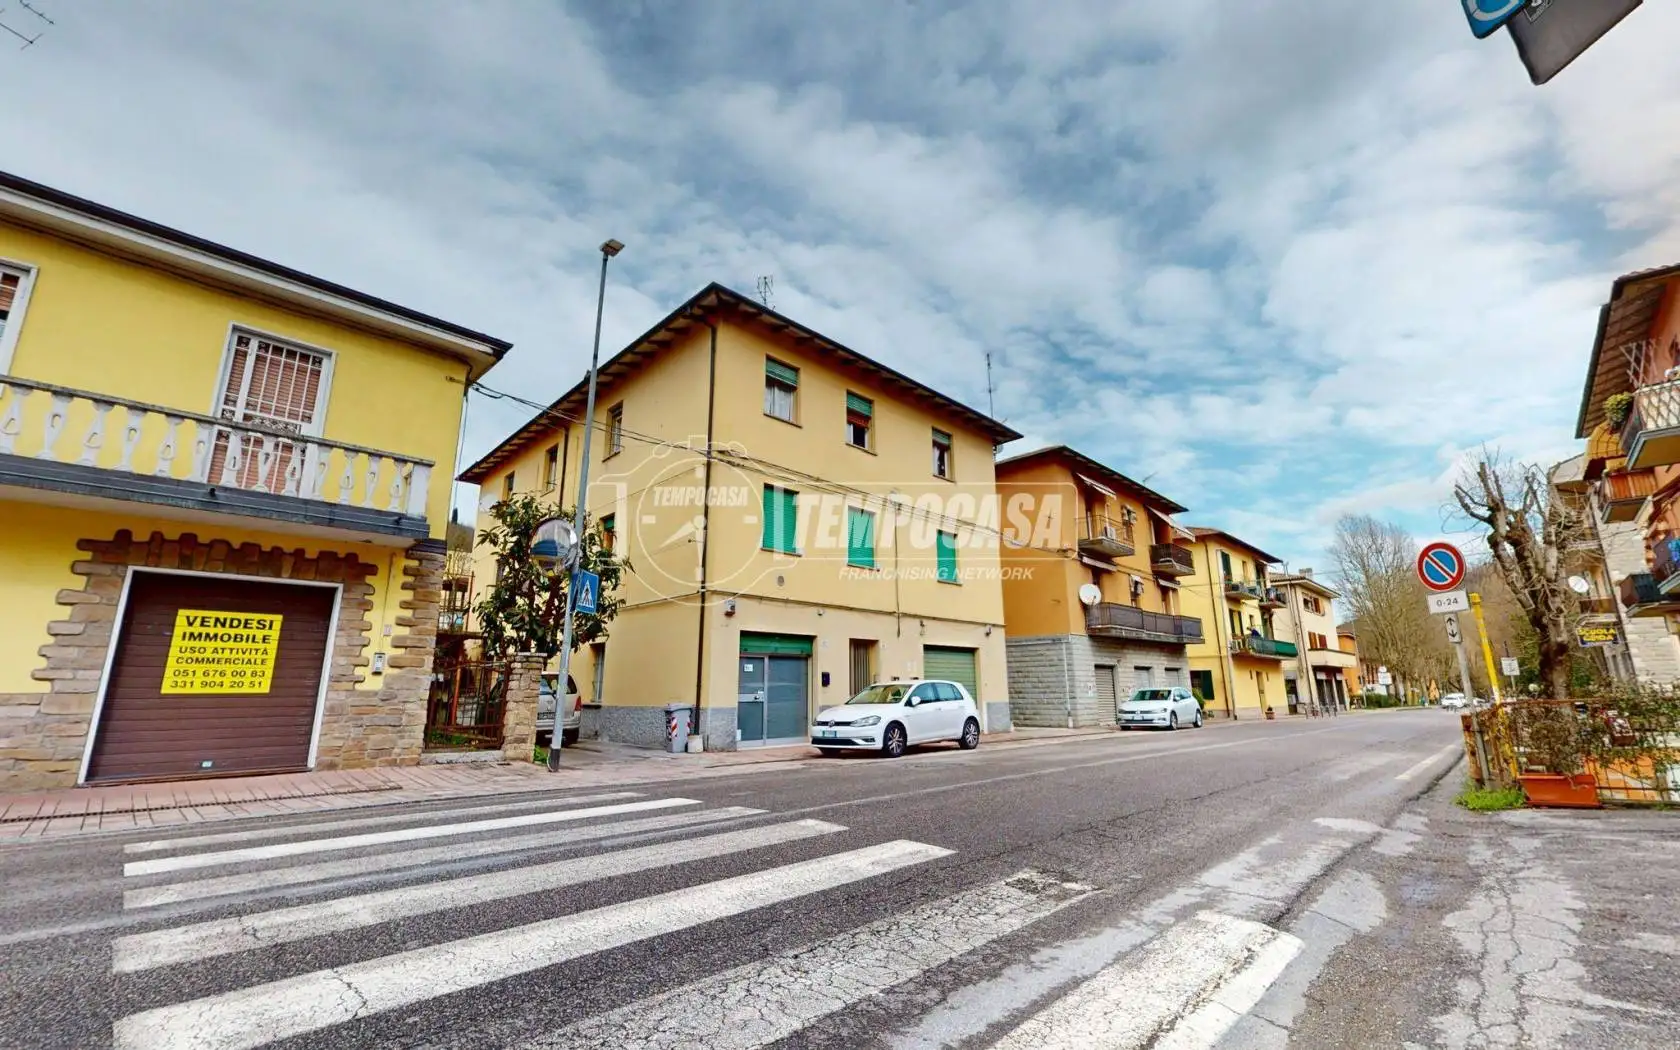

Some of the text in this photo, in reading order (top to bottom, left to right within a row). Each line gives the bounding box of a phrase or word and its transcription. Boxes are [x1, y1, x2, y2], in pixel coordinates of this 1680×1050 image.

[1436, 598, 1459, 607] 0-24
[185, 615, 274, 630] VENDESI
[182, 631, 272, 644] IMMOBILE
[178, 646, 269, 656] USO ATTIVITÀ
[175, 656, 268, 666] COMMERCIALE
[173, 669, 266, 678] 051 676 00 83
[170, 680, 263, 688] 331 904 20 51
